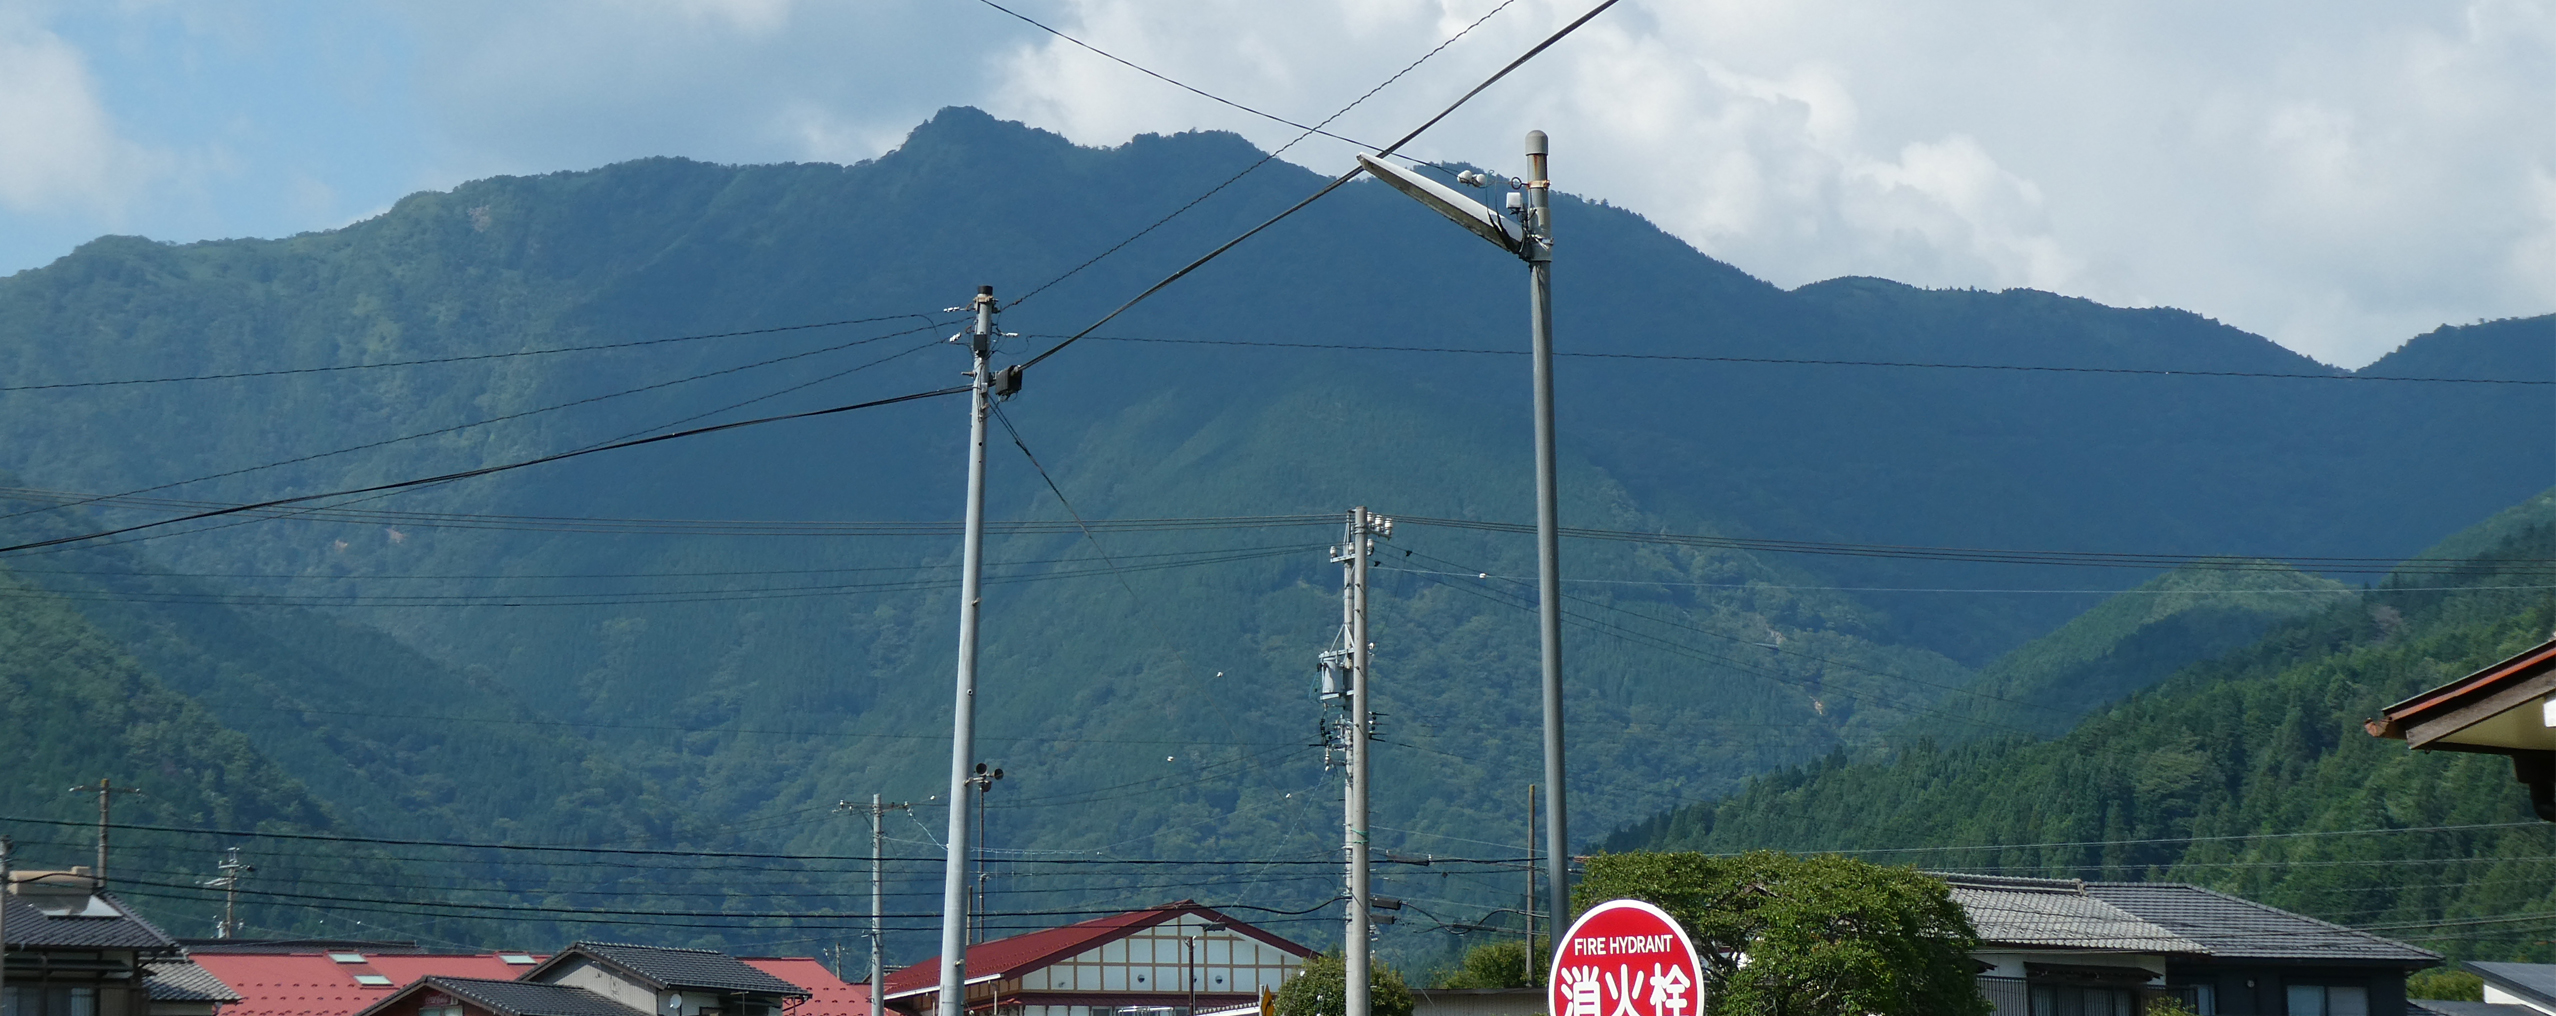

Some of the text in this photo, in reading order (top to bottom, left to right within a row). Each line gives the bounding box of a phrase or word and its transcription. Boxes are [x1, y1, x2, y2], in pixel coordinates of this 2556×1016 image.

[1574, 934, 1674, 956] FIRE HYDRANT
[1561, 962, 1691, 1016] 消火栓
